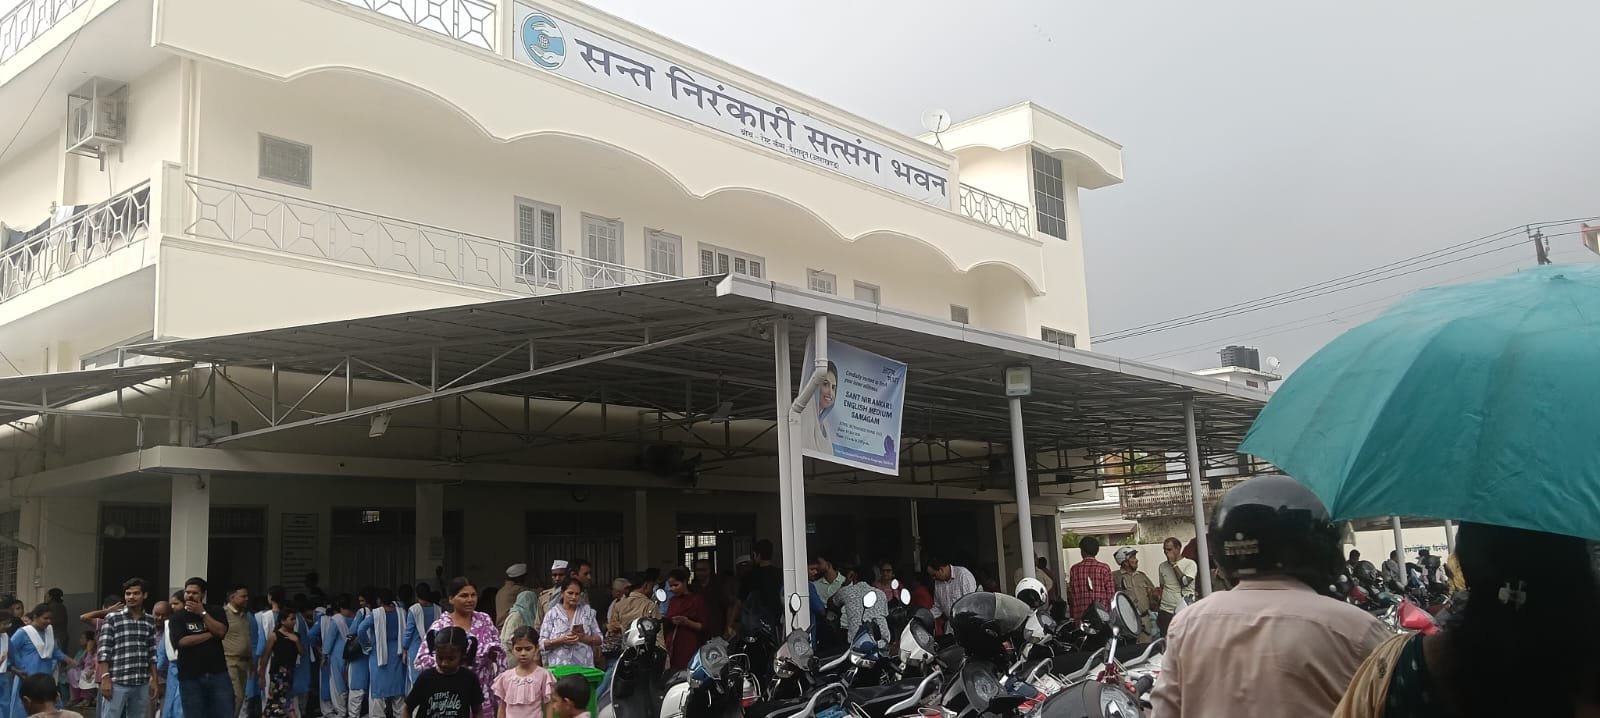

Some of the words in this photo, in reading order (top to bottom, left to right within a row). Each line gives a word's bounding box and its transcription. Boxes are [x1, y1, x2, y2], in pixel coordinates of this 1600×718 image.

[574, 38, 656, 91] सन्त
[665, 66, 796, 142] निरंकारी
[804, 124, 882, 174] सत्संग
[890, 159, 948, 197] भवन
[845, 391, 861, 401] SANT
[844, 400, 867, 412] ENGLISH
[868, 407, 892, 418] MEDIUM
[851, 412, 880, 425] SAMAGAM
